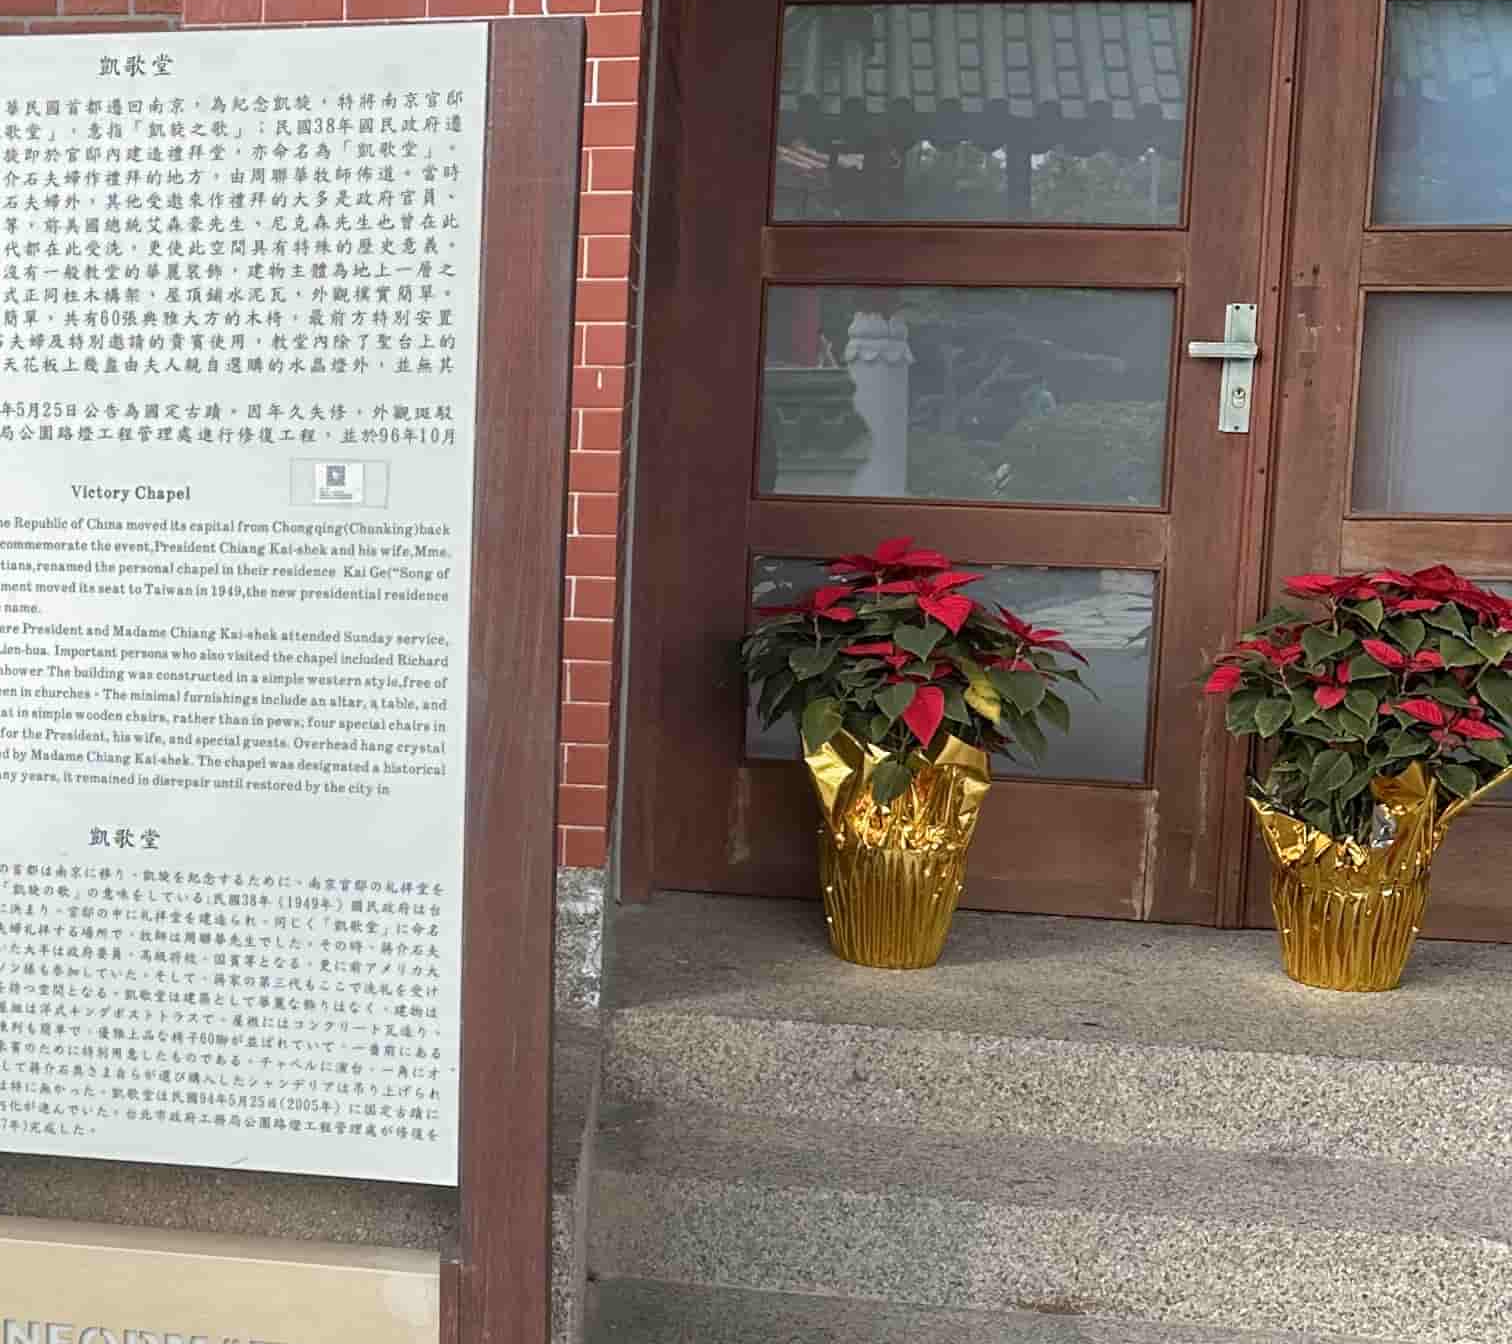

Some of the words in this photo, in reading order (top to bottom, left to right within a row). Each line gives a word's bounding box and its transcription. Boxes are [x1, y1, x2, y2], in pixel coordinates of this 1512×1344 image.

[95, 53, 174, 79] 凱歌堂
[71, 484, 131, 505] Victory
[134, 484, 191, 504] Chapel
[13, 516, 69, 532] Republic
[85, 517, 124, 531] China
[125, 519, 169, 532] moved
[189, 519, 235, 536] capital
[237, 519, 270, 534] from
[0, 539, 88, 552] commemorate
[218, 541, 267, 558] Chiang
[268, 541, 329, 556] Kai-shek
[330, 543, 356, 557] and
[357, 543, 378, 558] his
[94, 560, 116, 573] the
[118, 561, 175, 577] personal
[175, 561, 220, 578] chapel
[236, 562, 270, 577] their
[271, 563, 337, 579] residence
[343, 564, 367, 579] Kai
[35, 581, 77, 593] moved
[78, 582, 96, 594] its
[97, 583, 126, 595] seat
[143, 582, 194, 597] Taiwan
[270, 587, 297, 599] new
[299, 586, 382, 603] presidential
[383, 587, 449, 602] residence
[21, 621, 84, 636] President
[85, 623, 110, 638] and
[112, 624, 167, 639] Madame
[169, 625, 217, 643] Chiang
[219, 626, 279, 641] Kai-shek
[280, 629, 341, 643] attended
[343, 631, 394, 647] Sunday
[54, 644, 118, 660] Important
[120, 648, 169, 662] persons
[170, 647, 198, 661] who
[199, 648, 225, 662] also
[226, 649, 270, 663] visited
[272, 649, 294, 664] the
[296, 650, 338, 668] chapel
[340, 652, 395, 667] included
[396, 653, 449, 668] Richard
[46, 664, 72, 679] The
[73, 665, 126, 683] building
[127, 671, 153, 681] was
[155, 669, 233, 683] constructed
[261, 671, 305, 688] simple
[306, 674, 363, 687] western
[34, 685, 92, 700] churches
[101, 687, 128, 701] The
[130, 689, 181, 703] minimal
[183, 690, 259, 708] furnishings
[260, 692, 308, 707] include
[421, 698, 448, 712] and
[31, 706, 73, 723] simple
[74, 708, 123, 722] wooden
[172, 711, 217, 726] rather
[218, 712, 250, 726] than
[306, 715, 337, 729] four
[338, 717, 387, 733] special
[388, 719, 431, 733] chairs
[0, 726, 20, 739] for
[21, 727, 43, 741] the
[112, 729, 132, 744] his
[168, 732, 193, 745] and
[194, 734, 241, 749] special
[293, 735, 358, 752] Overhead
[359, 738, 395, 755] hang
[395, 740, 446, 757] crystal
[30, 748, 84, 763] Madame
[86, 750, 132, 767] Chiang
[195, 753, 222, 768] The
[222, 755, 267, 773] chapel
[267, 759, 295, 771] was
[296, 757, 370, 775] designated
[383, 759, 447, 777] historical
[74, 772, 136, 785] remained
[151, 773, 212, 790] disrepair
[212, 776, 244, 790] until
[245, 779, 303, 793] restored
[323, 780, 346, 793] the
[347, 781, 374, 798] city
[87, 825, 161, 851] 凱歌堂
